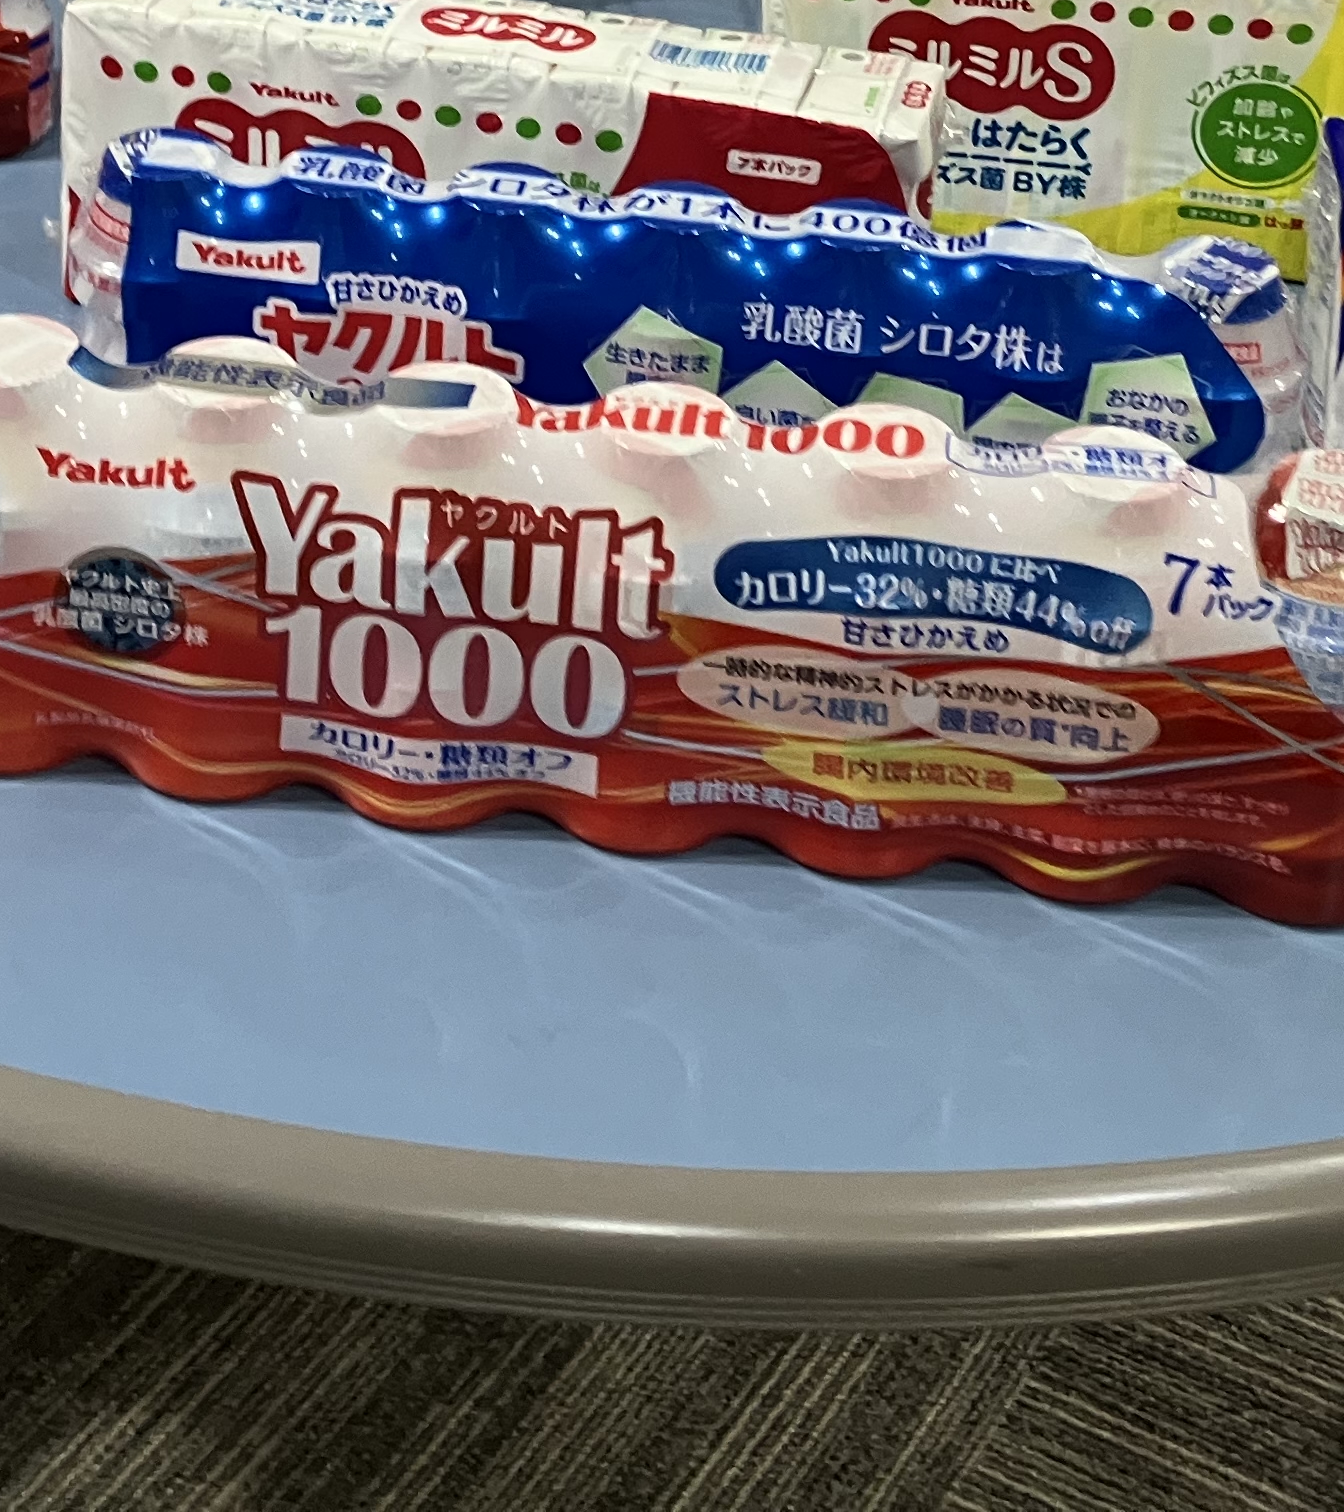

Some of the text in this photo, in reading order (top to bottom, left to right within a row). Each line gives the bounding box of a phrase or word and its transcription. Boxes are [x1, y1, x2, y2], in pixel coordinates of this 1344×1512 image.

[427, 7, 587, 49] ミルミル
[249, 82, 341, 107] Yakult
[971, 117, 1091, 160] はたらく
[1216, 119, 1307, 147] ストレスで
[1012, 171, 1087, 200] BY株
[192, 241, 307, 274] Yakult
[330, 279, 464, 316] 甘さひかえめ
[260, 303, 522, 377] ヤクルト
[741, 293, 1065, 375] 乳酸菌 シロタ株は
[606, 342, 711, 377] 生きたまま
[35, 446, 198, 493] Yakult
[441, 499, 568, 538] ヤクルト
[232, 472, 674, 641] Yakult
[842, 619, 1010, 655] 甘さひかえめ
[264, 609, 628, 739] 1000
